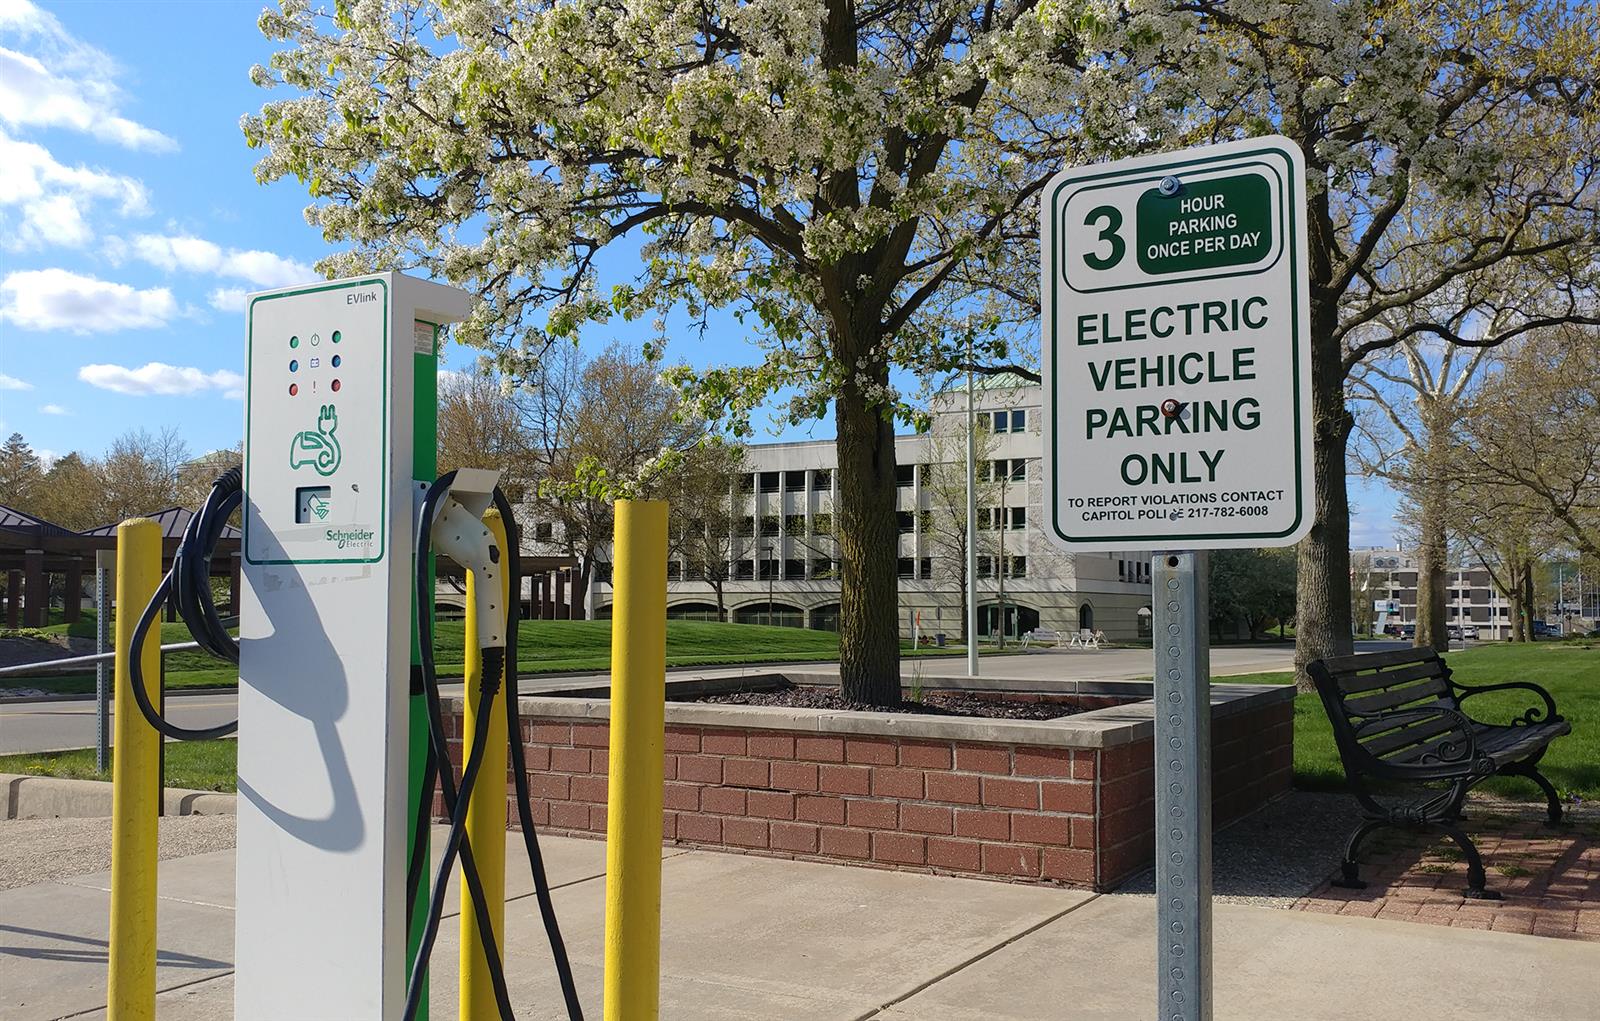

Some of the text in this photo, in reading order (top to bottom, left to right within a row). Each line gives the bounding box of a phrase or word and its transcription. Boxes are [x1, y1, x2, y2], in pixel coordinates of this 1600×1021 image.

[1181, 194, 1224, 214] HOUR
[1082, 205, 1126, 270] 3
[1169, 214, 1237, 236] PARKING
[1147, 232, 1262, 260] ONCE PER DAY
[347, 291, 377, 304] EVlink
[1077, 296, 1268, 345] ELECTRIC
[1088, 347, 1256, 391] VEHICLE
[1086, 397, 1261, 439] PARKING
[1120, 450, 1225, 485] ONLY
[1068, 490, 1284, 508] TO REPORT VIOLATIONS CONTACT
[1082, 506, 1268, 521] CAPITOL POLIE 217-782-6008
[327, 529, 374, 540] Schneider
